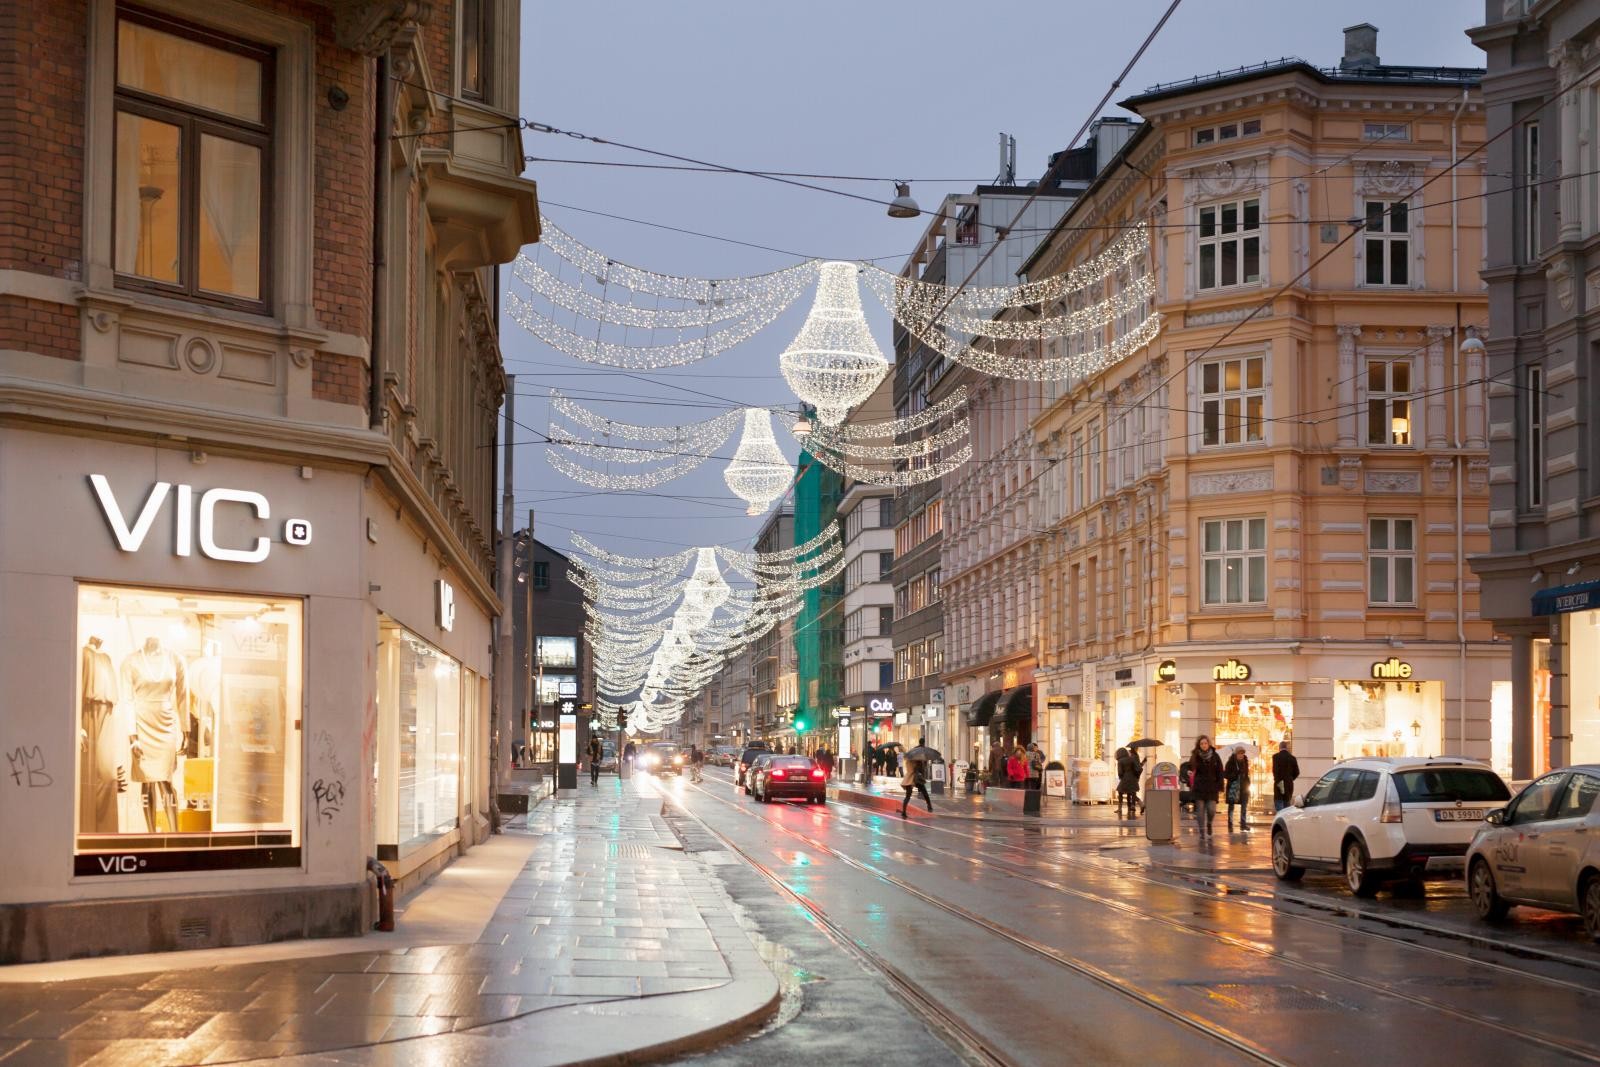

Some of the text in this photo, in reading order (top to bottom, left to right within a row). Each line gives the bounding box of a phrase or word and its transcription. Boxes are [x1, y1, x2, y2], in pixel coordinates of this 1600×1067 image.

[88, 473, 271, 564] VIC
[1213, 660, 1248, 680] nille
[1373, 658, 1411, 678] nille
[98, 855, 137, 873] VIC
